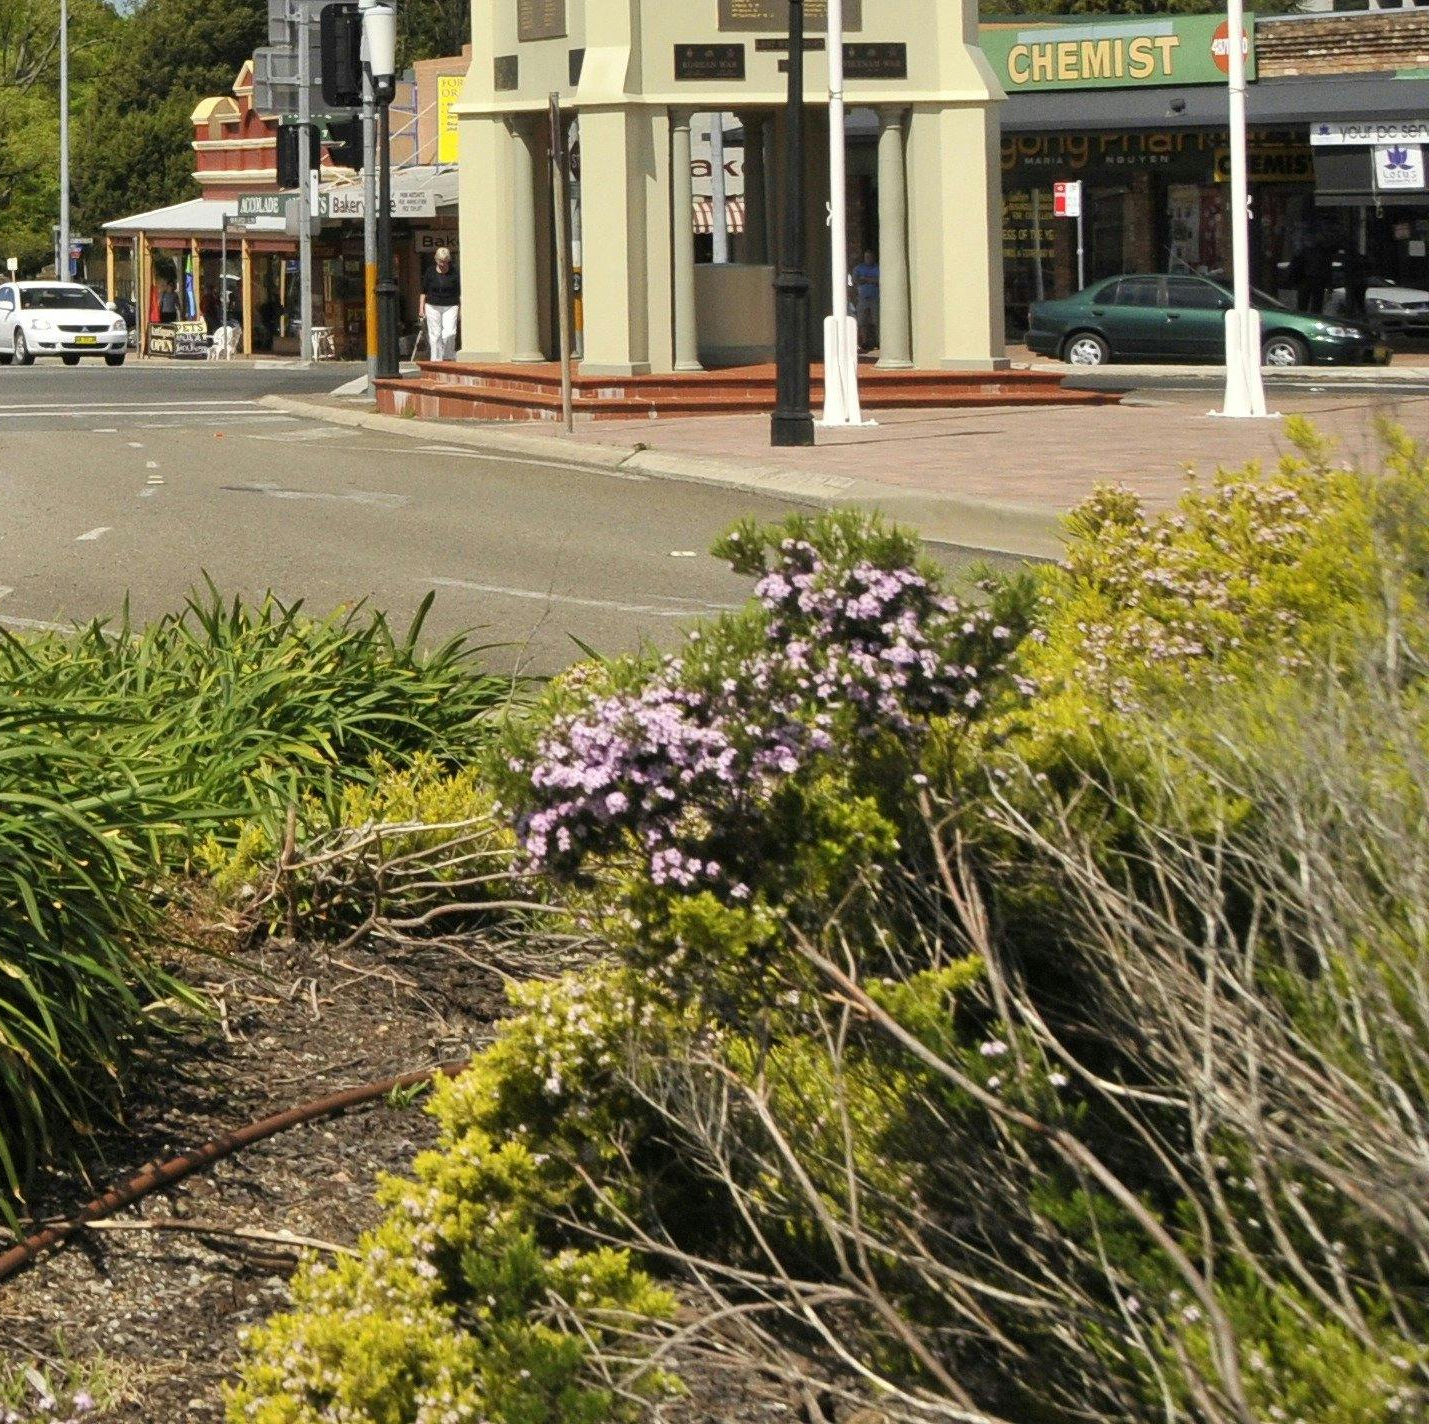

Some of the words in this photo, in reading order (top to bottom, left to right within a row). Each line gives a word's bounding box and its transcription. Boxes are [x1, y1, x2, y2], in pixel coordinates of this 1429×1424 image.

[1007, 34, 1180, 85] CHEMIST
[1339, 125, 1374, 143] your
[1376, 126, 1399, 143] pc
[1024, 156, 1064, 165] MARIA
[1105, 155, 1169, 165] NGUYEN
[1216, 154, 1313, 176] CEMIS
[422, 236, 458, 248] Bak
[151, 338, 173, 353] OPEN
